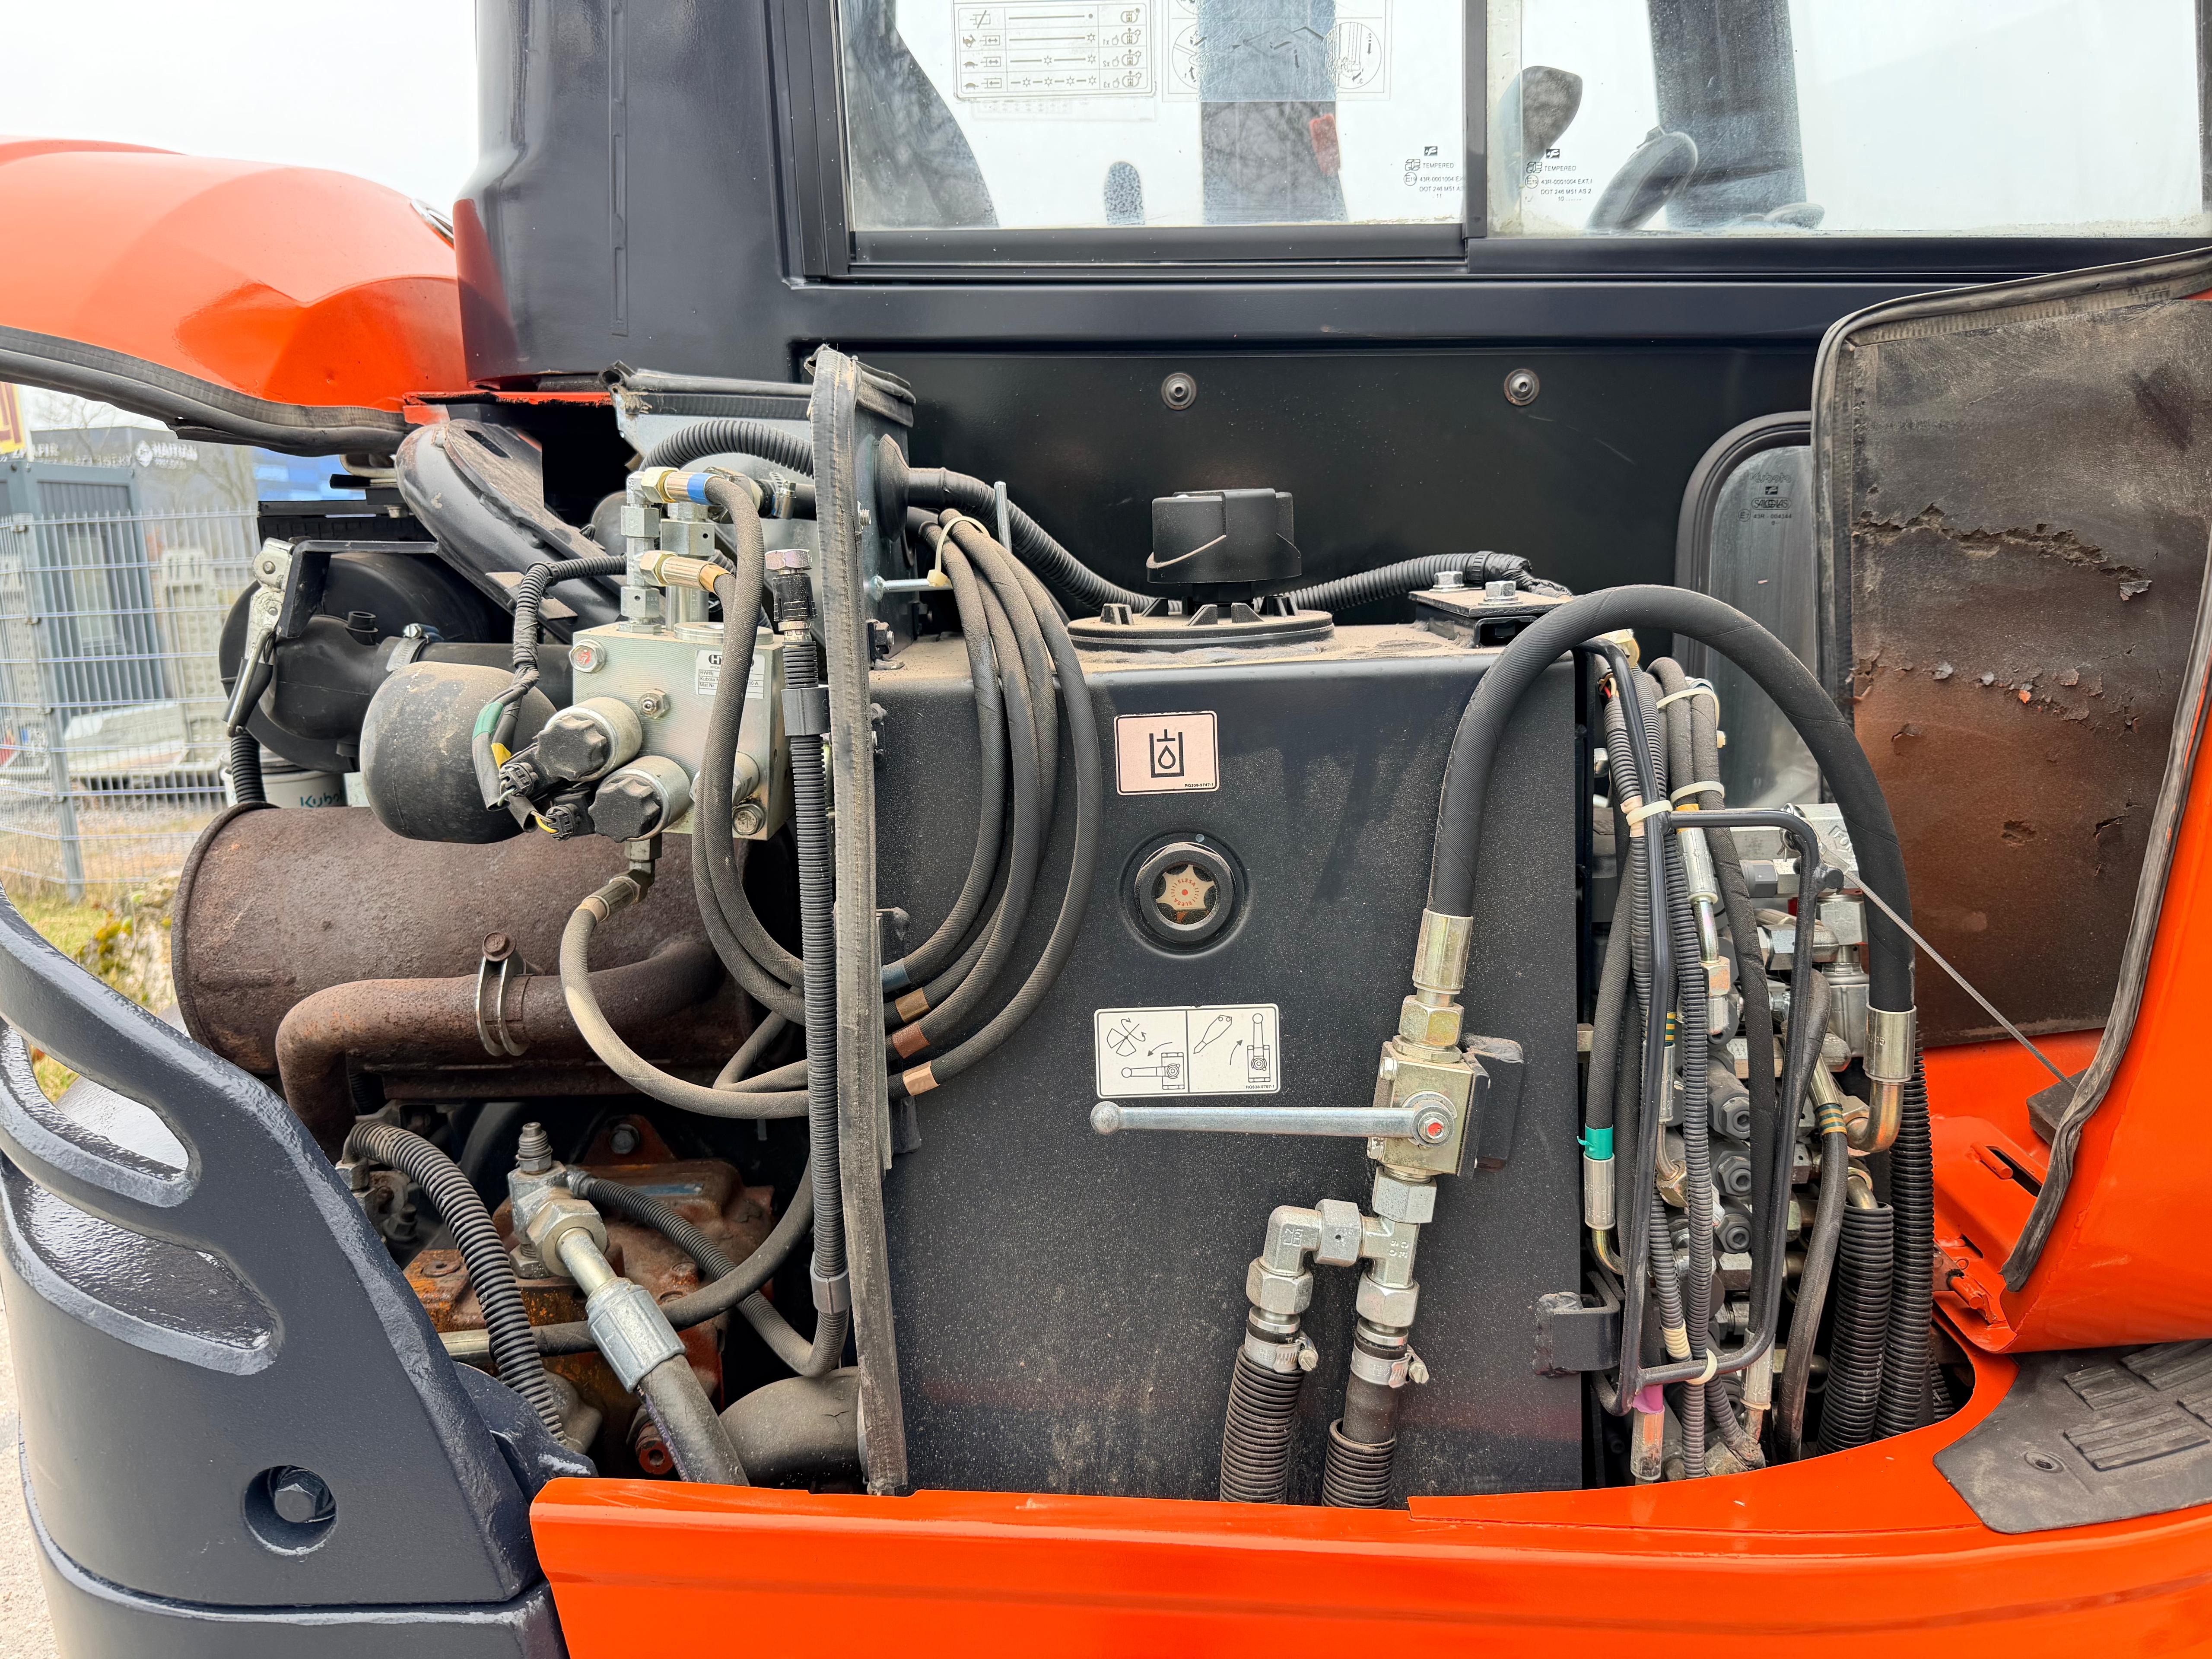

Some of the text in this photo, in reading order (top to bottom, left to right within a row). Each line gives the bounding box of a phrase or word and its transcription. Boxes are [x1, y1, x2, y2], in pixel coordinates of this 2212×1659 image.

[1750, 472, 1792, 483] Kubota
[1178, 878, 1196, 887] ELESA
[1174, 898, 1192, 906] ELESA
